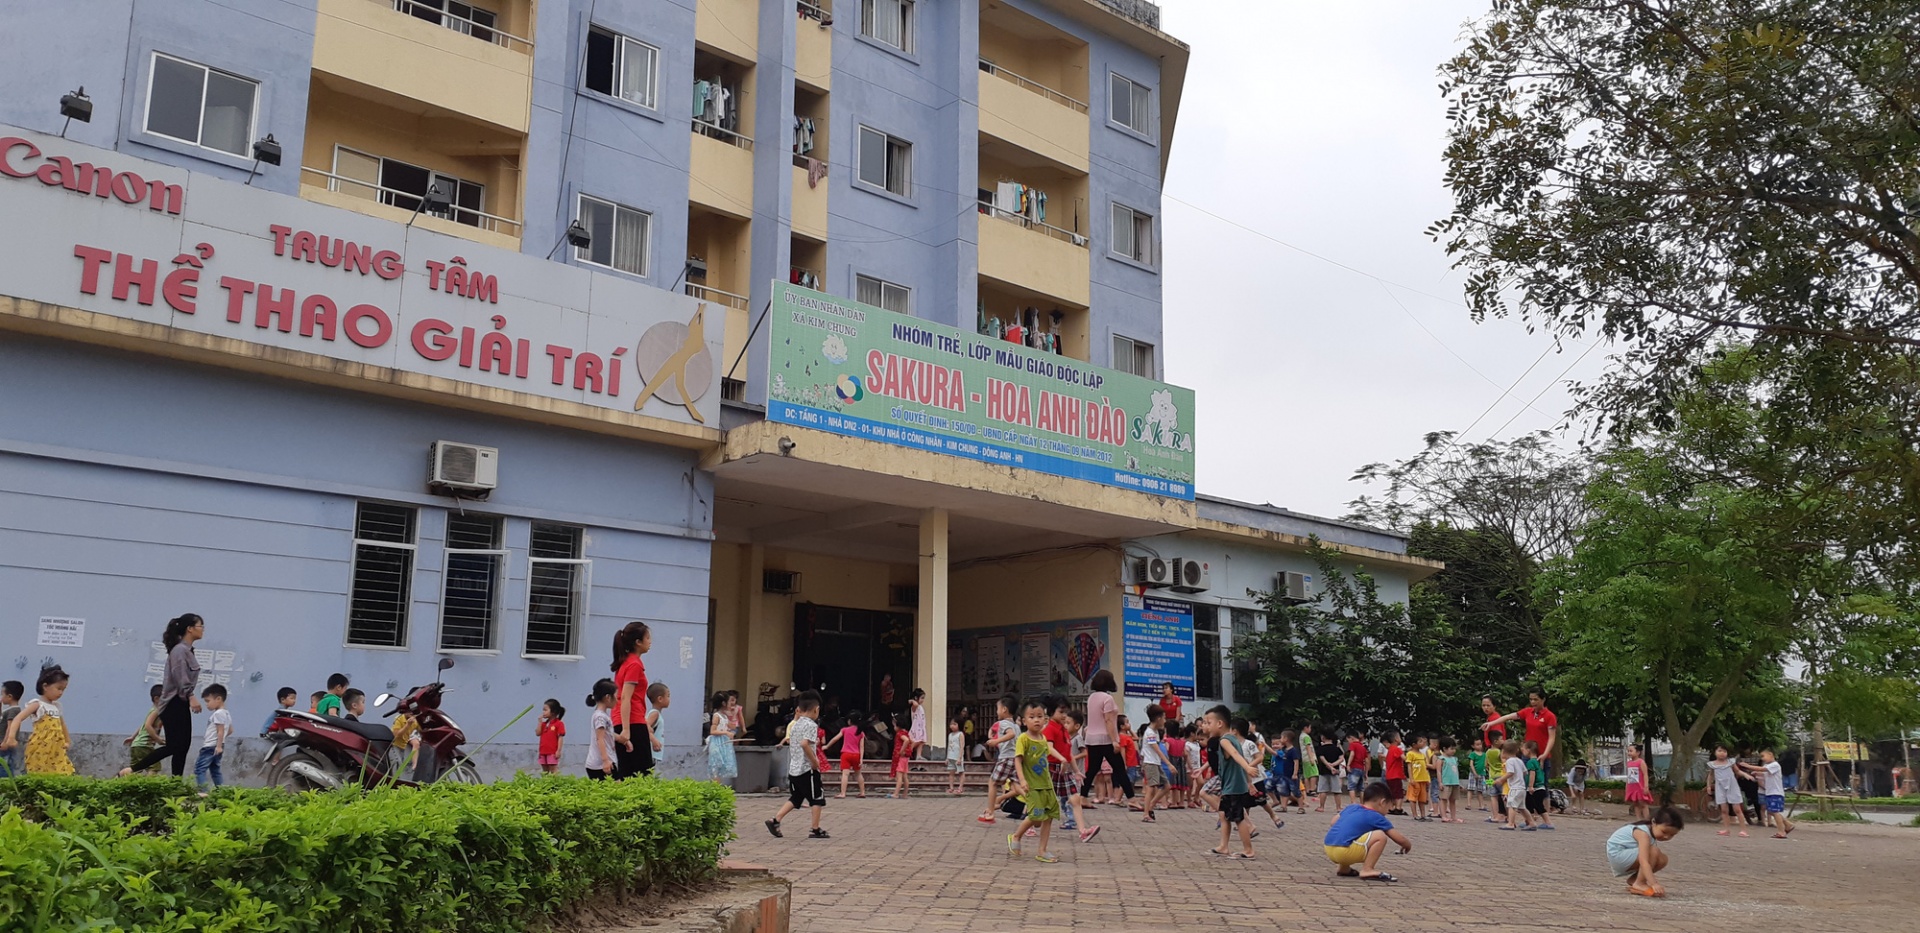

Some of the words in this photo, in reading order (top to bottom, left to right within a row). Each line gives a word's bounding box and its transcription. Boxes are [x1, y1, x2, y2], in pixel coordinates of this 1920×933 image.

[0, 136, 183, 215] Canon
[269, 223, 405, 280] TRUNG
[426, 255, 498, 304] TÂM
[74, 242, 215, 315] THỂ
[220, 275, 393, 348] THAO
[410, 314, 530, 379] GIẢI
[546, 343, 628, 397] TRÍ
[800, 296, 818, 310] BAN
[820, 300, 845, 317] NHÂN
[847, 307, 865, 322] DÂN
[808, 316, 825, 329] KIM
[827, 322, 857, 337] CHUNG
[892, 323, 933, 348] NHÓM
[937, 332, 964, 358] TRẺ,
[968, 341, 992, 362] LỚP
[995, 347, 1023, 371] MẪU
[1026, 356, 1053, 376] GIÁO
[1057, 365, 1079, 387] ĐỘC
[1083, 371, 1104, 392] LẬP
[867, 349, 966, 413] SAKURA
[987, 378, 1032, 427] HOA
[1038, 391, 1080, 437] ANH
[1084, 395, 1126, 446] ĐÀO
[819, 415, 824, 424] 1
[828, 415, 842, 428] NHÀ
[843, 419, 857, 431] DN2
[872, 425, 886, 437] KHU
[886, 426, 900, 439] NHÀ
[907, 430, 925, 443] CÔNG
[925, 432, 943, 447] NHÂN
[946, 439, 958, 449] KIM
[958, 442, 979, 455] CHUNG
[982, 445, 999, 458] ĐÔNG
[999, 450, 1012, 461] ANH
[1015, 454, 1024, 464] HN
[891, 405, 903, 419] SỐ
[904, 409, 927, 424] QUYẾT
[928, 416, 950, 430] ĐỊNH:
[951, 420, 976, 435] 150/QĐ
[982, 426, 1002, 440] UBND
[1004, 429, 1018, 443] CẤP
[1019, 433, 1038, 448] NGÀY
[1039, 439, 1047, 449] 12
[1049, 440, 1071, 454] THÁNG
[1071, 446, 1080, 456] 09
[1081, 447, 1096, 459] NĂM
[1097, 451, 1113, 463] 2012
[1131, 415, 1193, 453] SAKURA
[1115, 472, 1141, 486] Hotline:
[1142, 477, 1159, 489] 0906
[1160, 481, 1168, 491] 21
